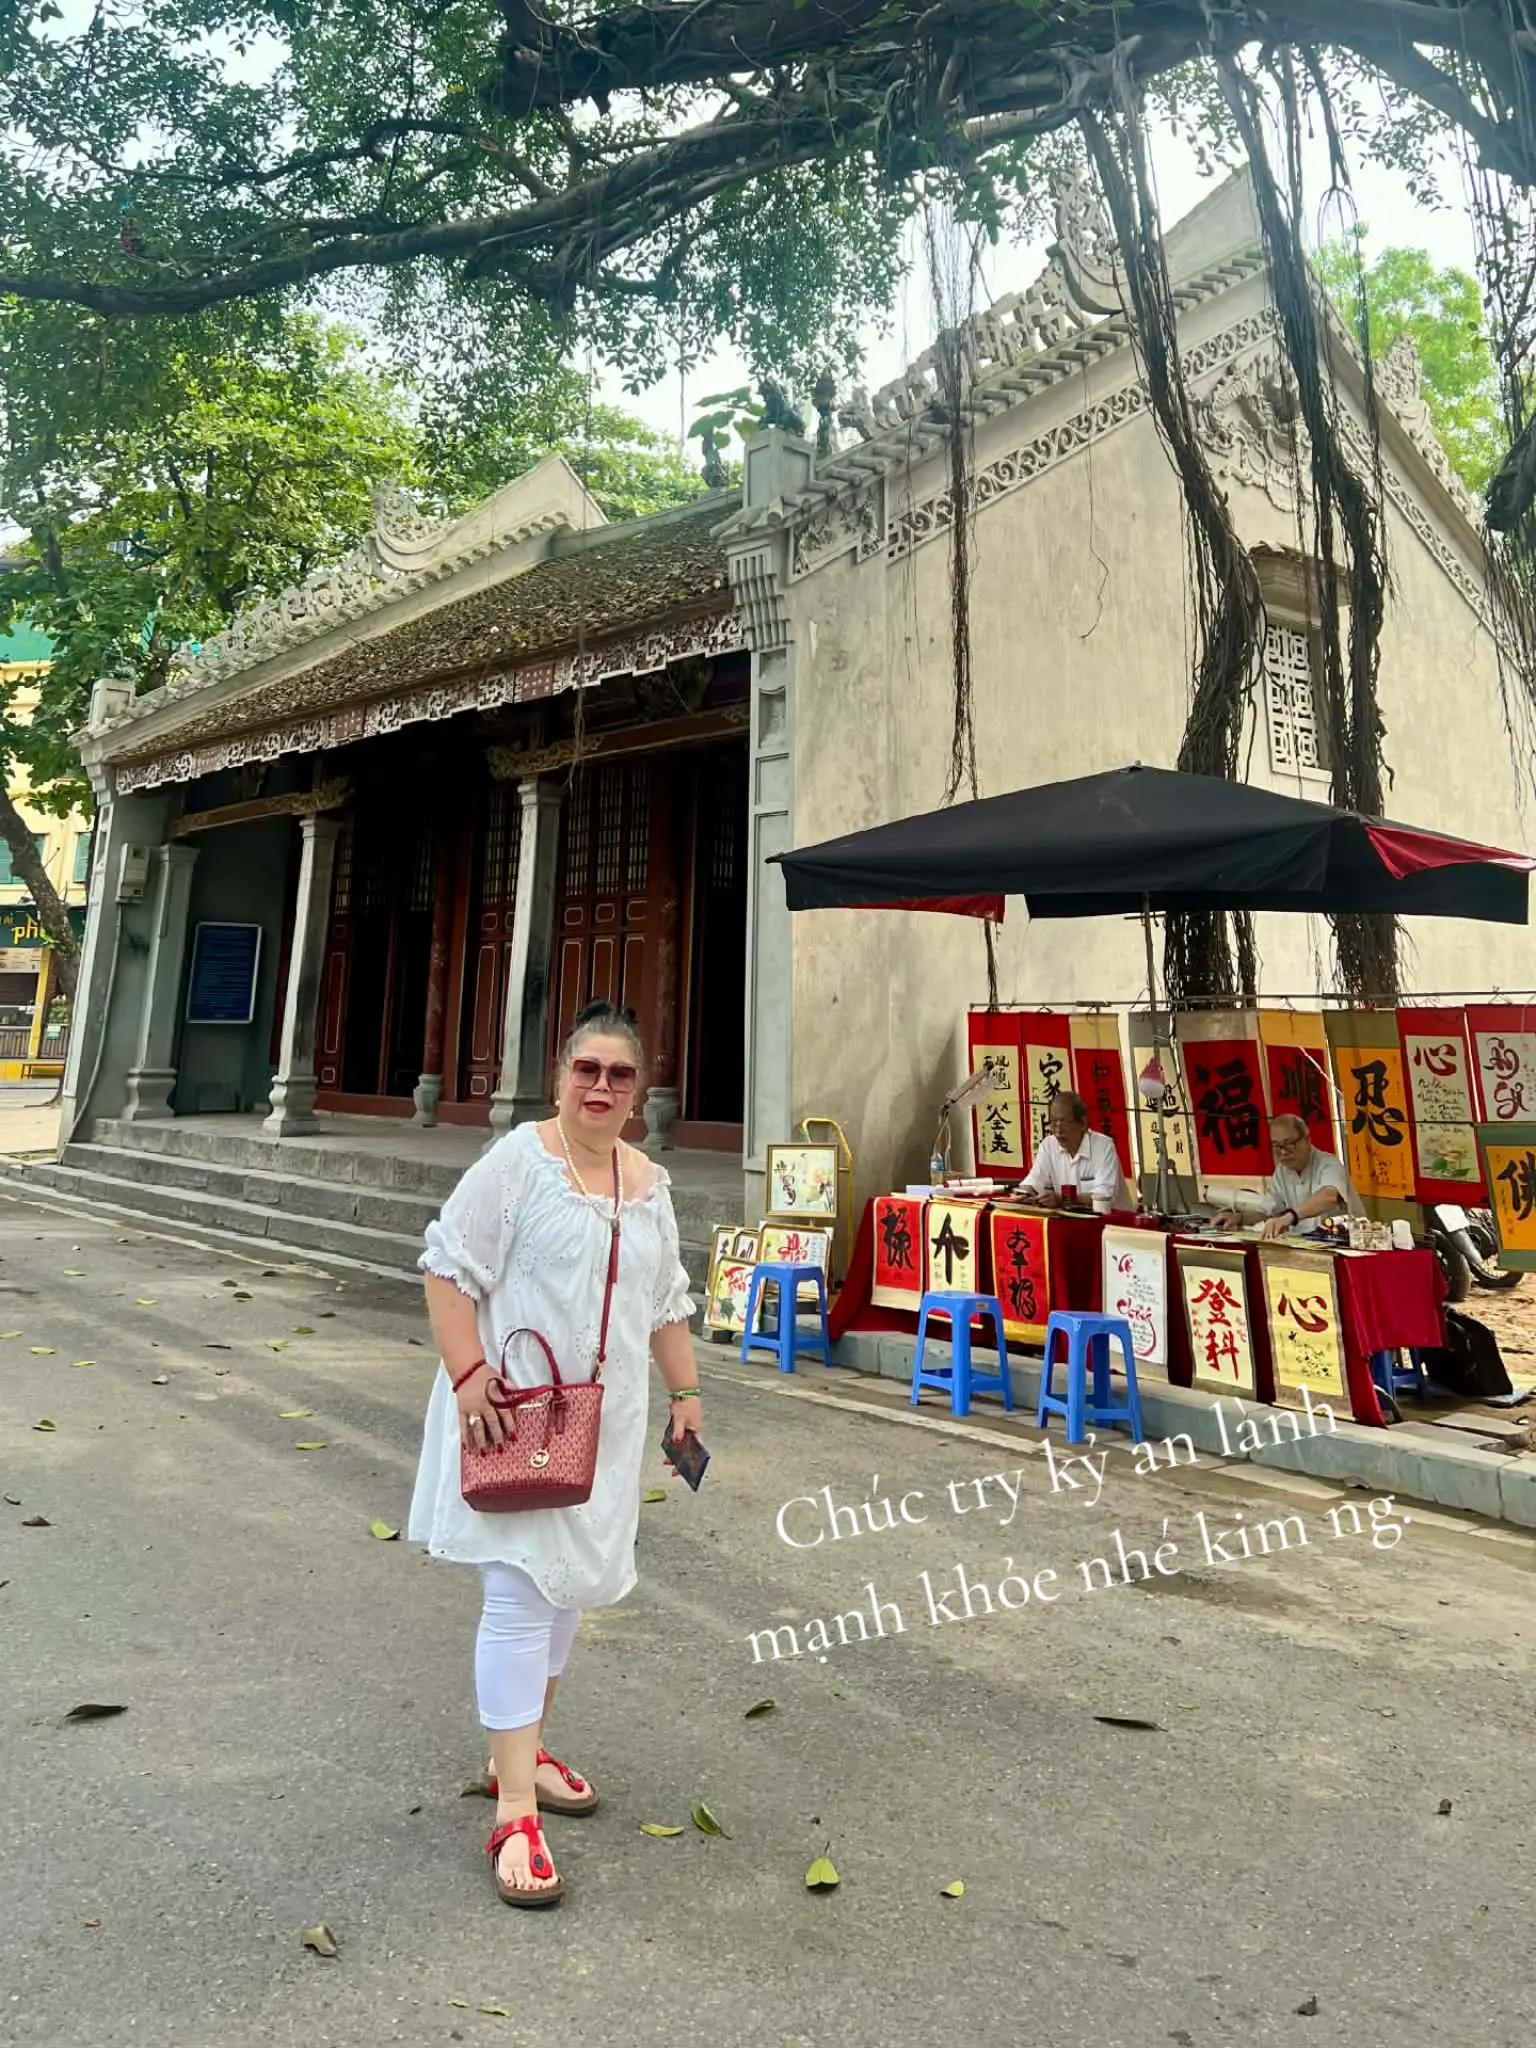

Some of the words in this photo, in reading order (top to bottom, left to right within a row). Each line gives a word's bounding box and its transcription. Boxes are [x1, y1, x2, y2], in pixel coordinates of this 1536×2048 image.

[1413, 1043, 1457, 1076] 心
[1194, 1059, 1260, 1155] 福
[1191, 1277, 1242, 1381] 登科
[1278, 1292, 1329, 1333] 心
